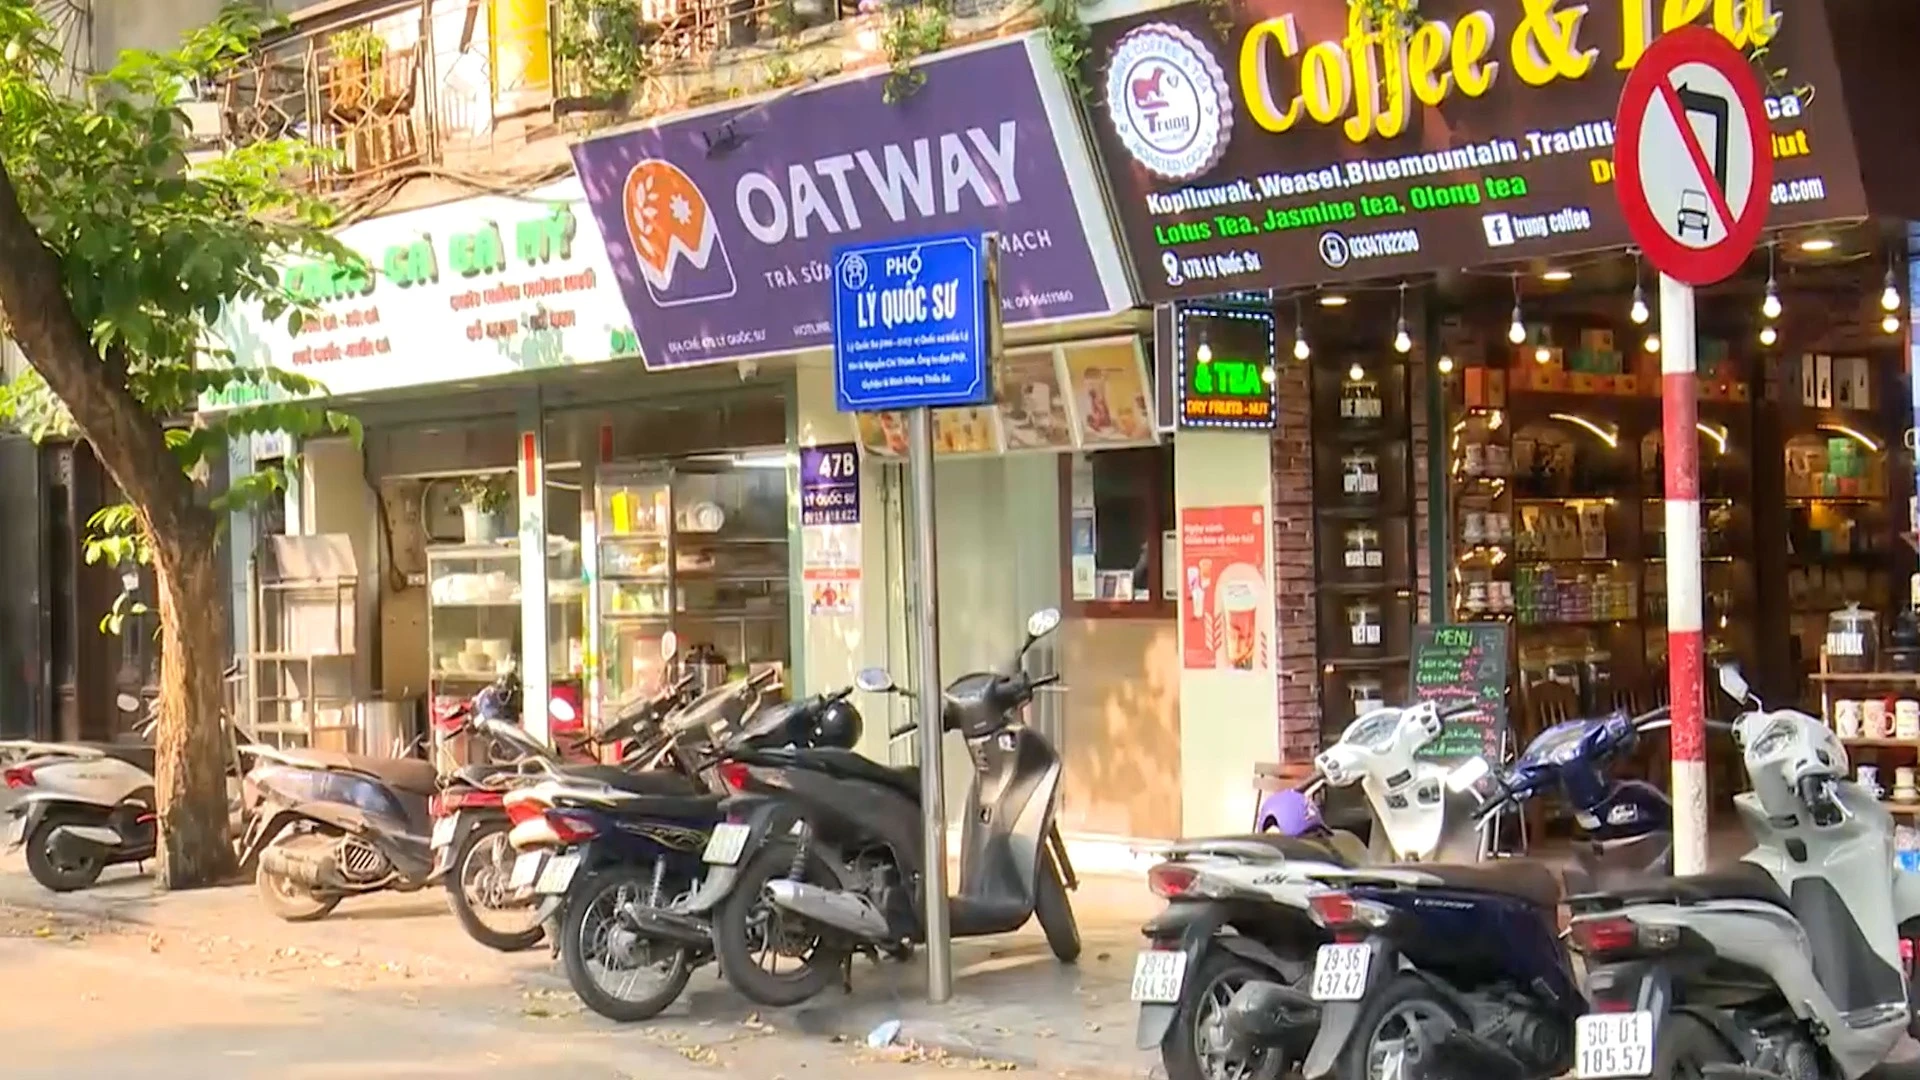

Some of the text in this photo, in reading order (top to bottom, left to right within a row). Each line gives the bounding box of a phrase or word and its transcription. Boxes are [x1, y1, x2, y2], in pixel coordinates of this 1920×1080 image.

[1240, 0, 1498, 142] Coffee
[1511, 0, 1599, 87] &
[1144, 110, 1189, 133] Trung
[1763, 94, 1801, 121] ca
[736, 120, 1022, 244] OATWAY
[1155, 219, 1212, 246] Lotus
[1214, 214, 1261, 239] Tea,
[1263, 200, 1356, 231] Jasmine
[1410, 182, 1480, 210] Olong
[1486, 174, 1527, 199] tea
[764, 264, 799, 288] TRÀ
[886, 245, 923, 277] PHỐ
[857, 274, 959, 330] LÝ QUỐC SƯ
[1213, 361, 1262, 394] TEA
[819, 452, 855, 479] 47B
[1434, 629, 1473, 647] MENU
[1582, 1044, 1646, 1075] 185.57
